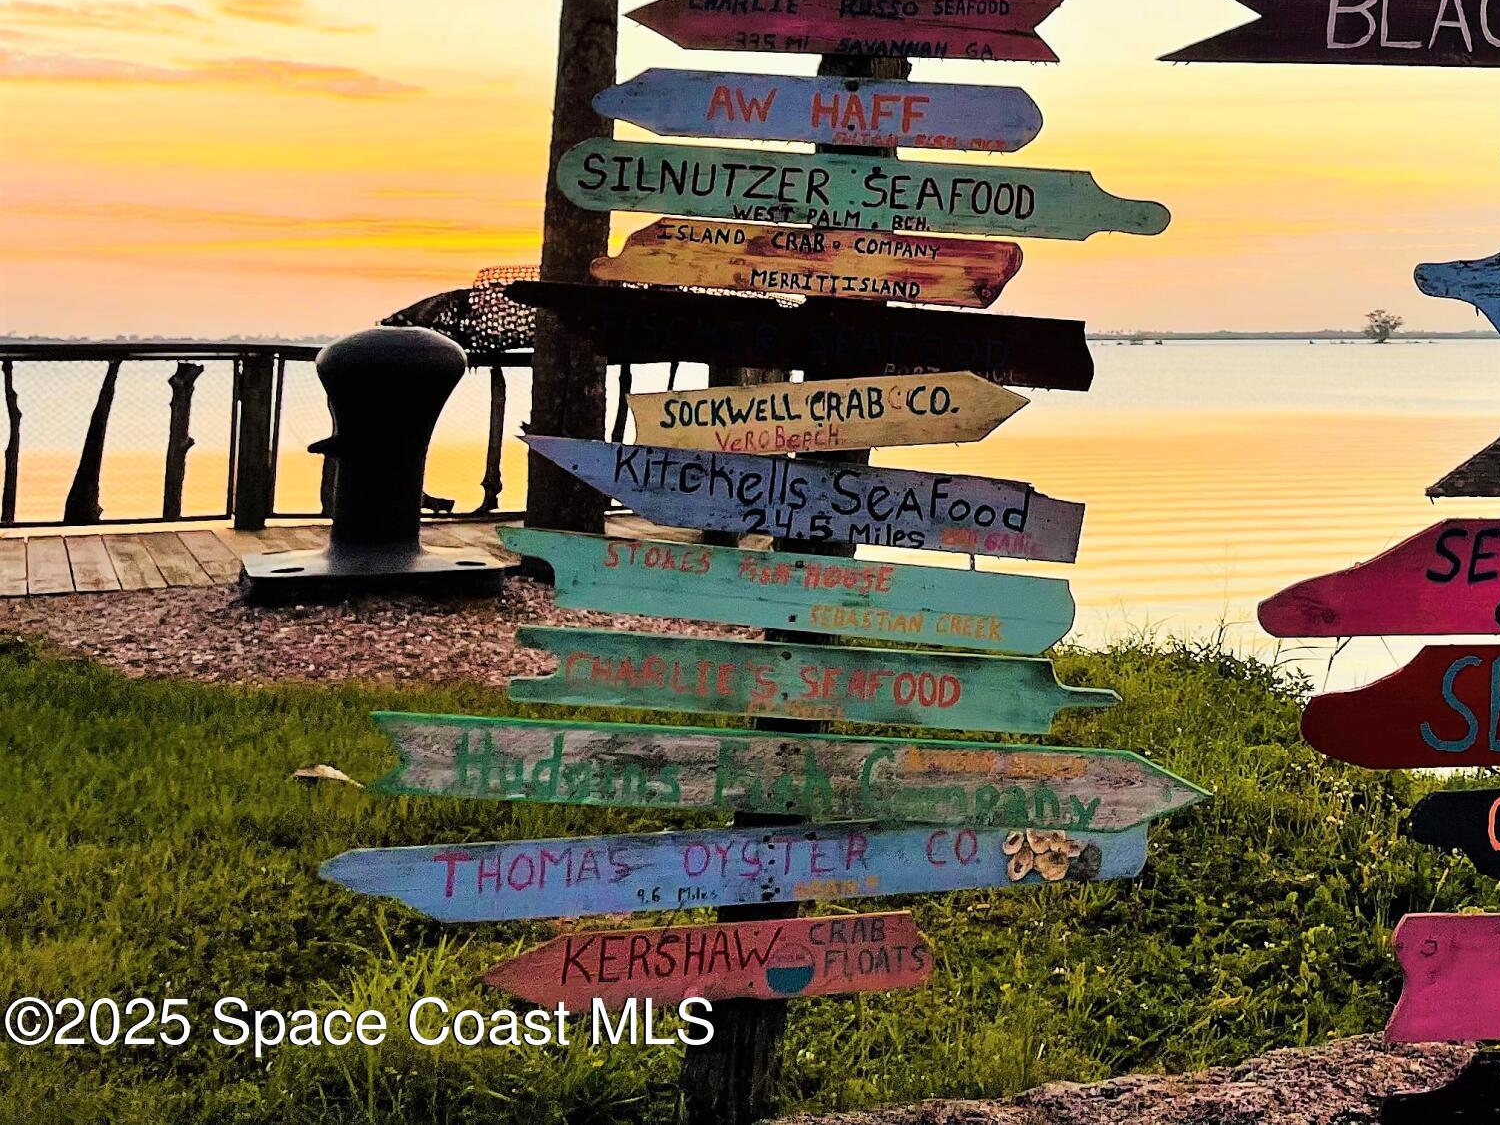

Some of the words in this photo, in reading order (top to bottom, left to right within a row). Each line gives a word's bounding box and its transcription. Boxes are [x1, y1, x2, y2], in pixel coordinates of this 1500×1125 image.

[834, 37, 948, 57] SAVANNAH
[706, 85, 780, 125] AW
[810, 91, 932, 134] HAFF
[577, 154, 831, 207] SILNUTZER
[862, 172, 1035, 220] SEAFOOD
[733, 202, 795, 225] WEST
[806, 205, 862, 229] PALM
[657, 225, 746, 246] ISLAND
[770, 230, 826, 253] CRAB
[854, 236, 940, 260] COMPANY
[660, 392, 802, 429] SOCKWELL
[808, 385, 886, 422] CRAB
[741, 509, 833, 539] 24.5
[809, 604, 922, 635] SEBASTIAN
[934, 611, 1003, 642] CREEK
[800, 666, 963, 709] SEAFOOD
[434, 845, 635, 898] THOMAS
[683, 833, 869, 879] OYSTER
[561, 926, 784, 986] KERSHAW
[808, 918, 885, 946] CRAB
[824, 944, 927, 981] FLOATS
